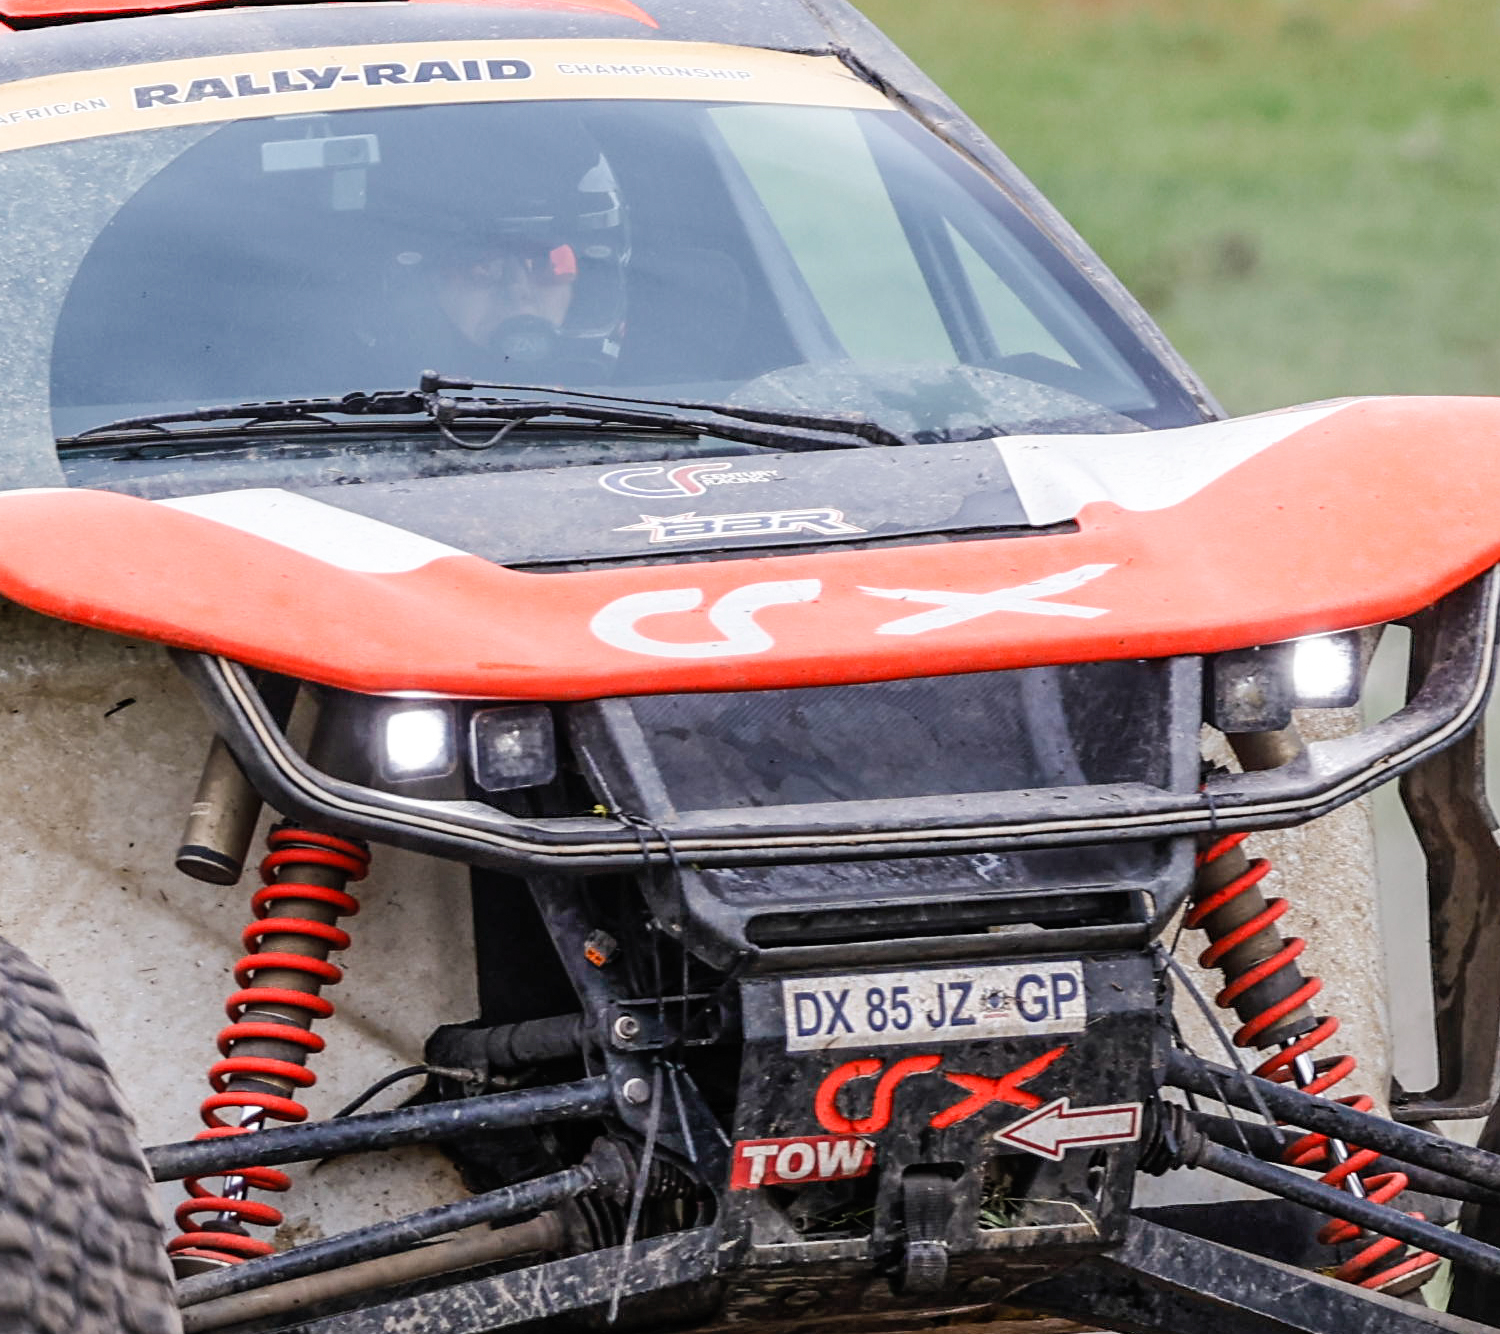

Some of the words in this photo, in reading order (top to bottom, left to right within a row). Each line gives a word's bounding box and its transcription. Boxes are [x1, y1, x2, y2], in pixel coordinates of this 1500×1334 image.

[133, 58, 532, 109] RALLY-RAID
[557, 63, 752, 82] CHAMPIONSHIP
[794, 986, 857, 1038] DX
[866, 984, 914, 1033] 85
[927, 979, 976, 1029] JZ
[1013, 971, 1079, 1024] GP
[741, 1139, 872, 1185] TOW
